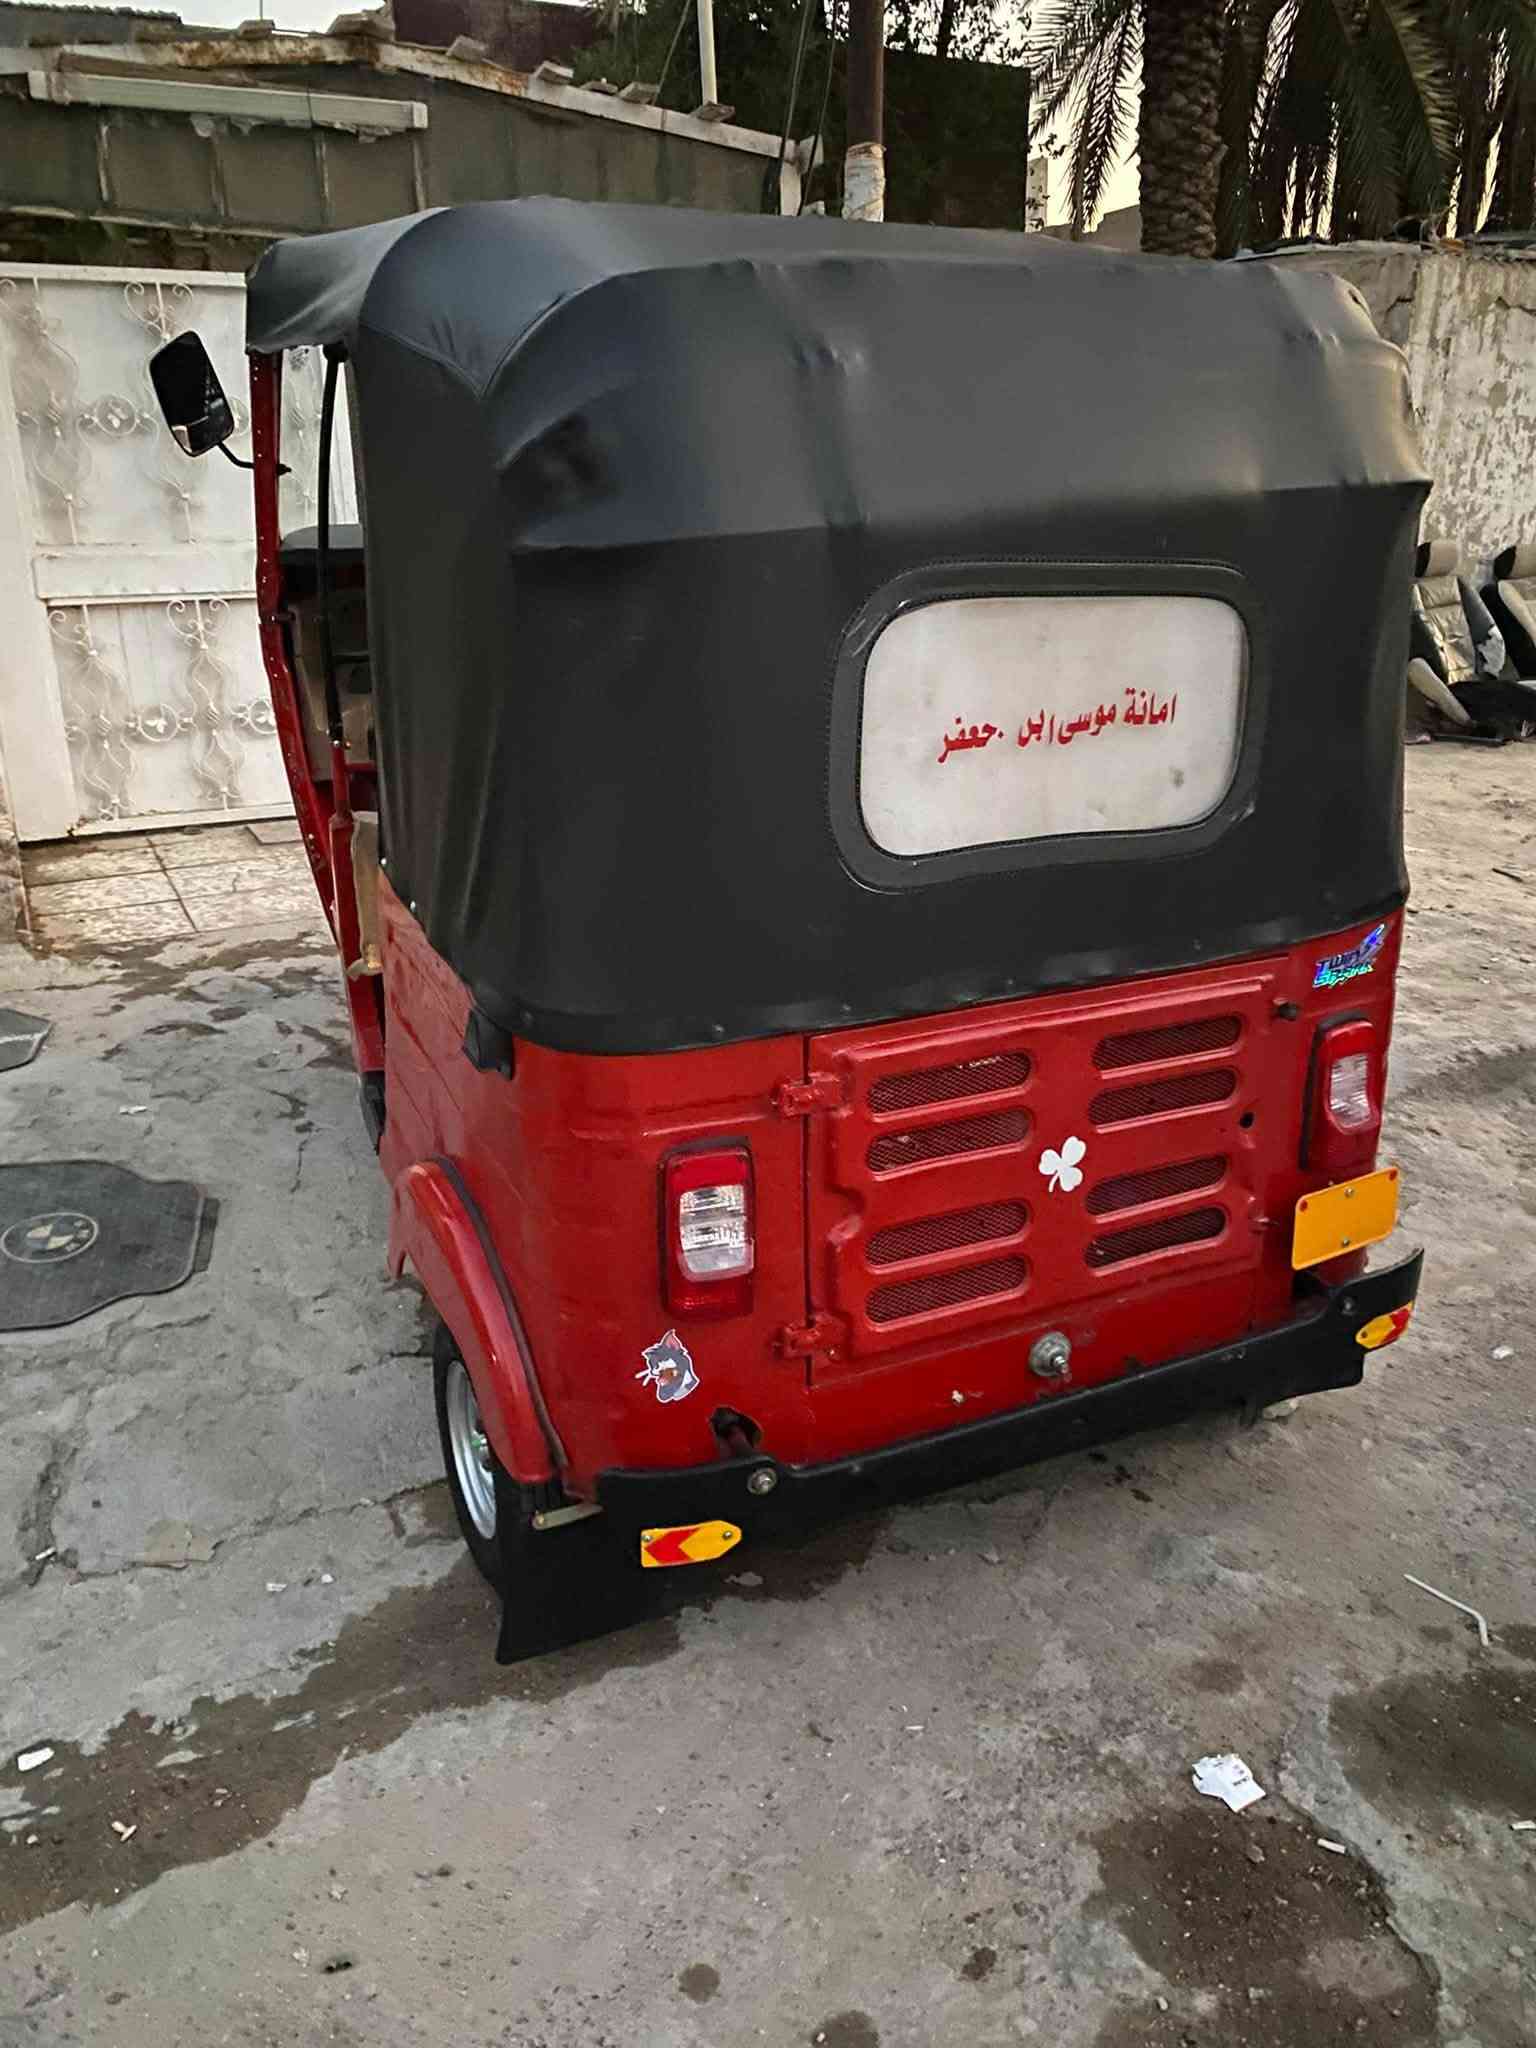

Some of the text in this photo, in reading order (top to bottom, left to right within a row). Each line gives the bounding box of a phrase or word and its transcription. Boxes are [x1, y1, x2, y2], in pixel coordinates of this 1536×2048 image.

[1057, 702, 1117, 745] موسى
[1123, 687, 1177, 725] امانة
[937, 716, 1004, 764] جعفر
